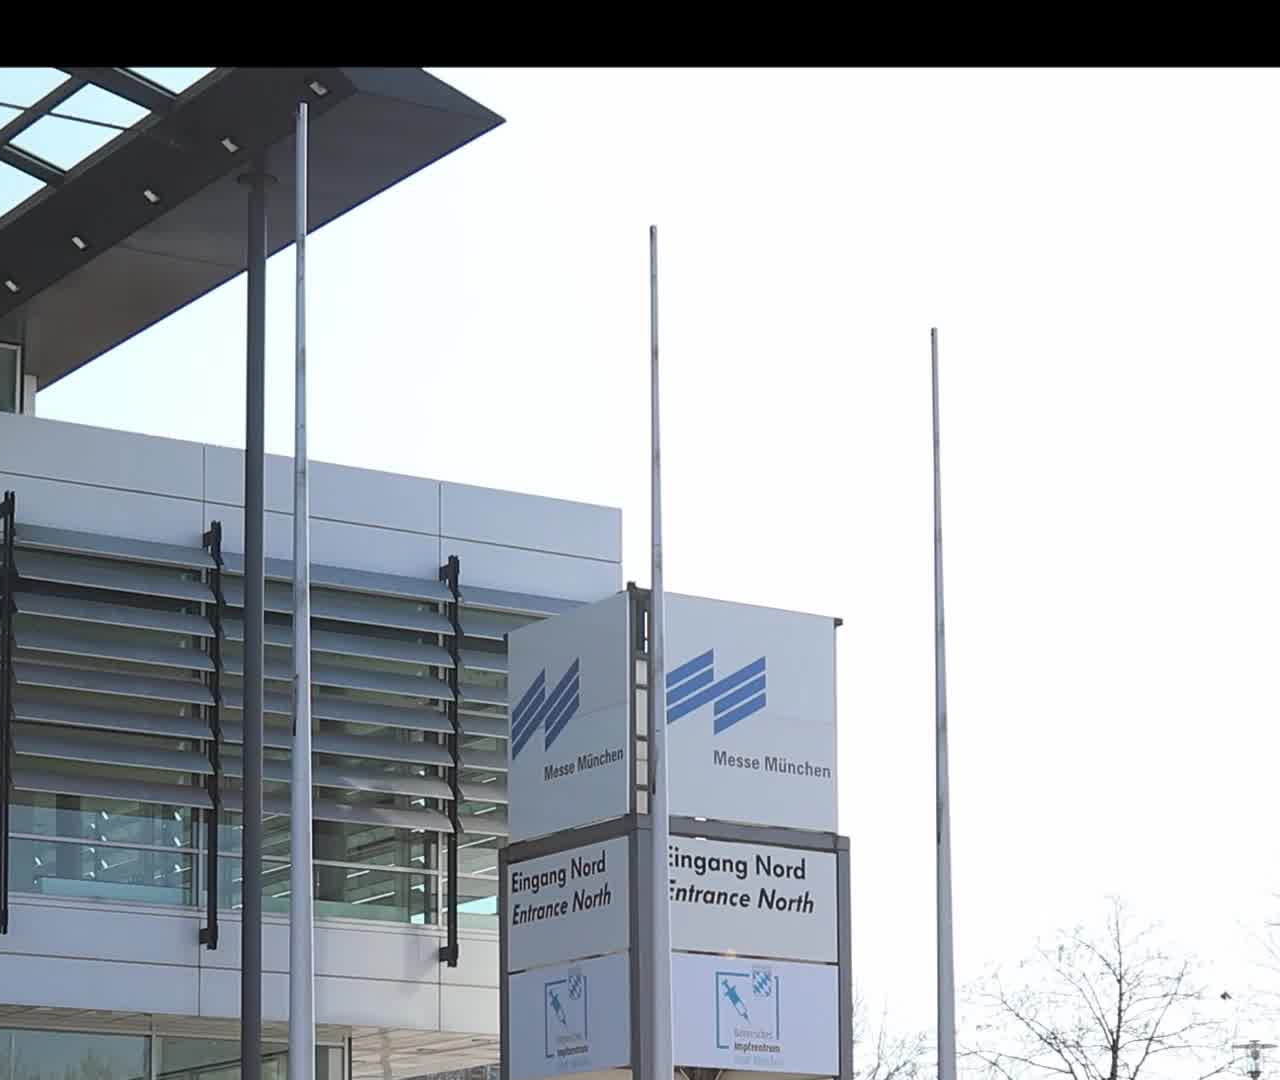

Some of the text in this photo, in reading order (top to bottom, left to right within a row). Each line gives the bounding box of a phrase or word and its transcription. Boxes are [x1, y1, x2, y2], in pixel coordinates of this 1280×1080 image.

[544, 748, 624, 781] Messe München
[713, 750, 832, 779] Messe München
[511, 849, 606, 895] Eingang Nord
[668, 845, 806, 880] ingang Nord
[512, 882, 612, 926] Entrance North
[758, 887, 815, 914] North
